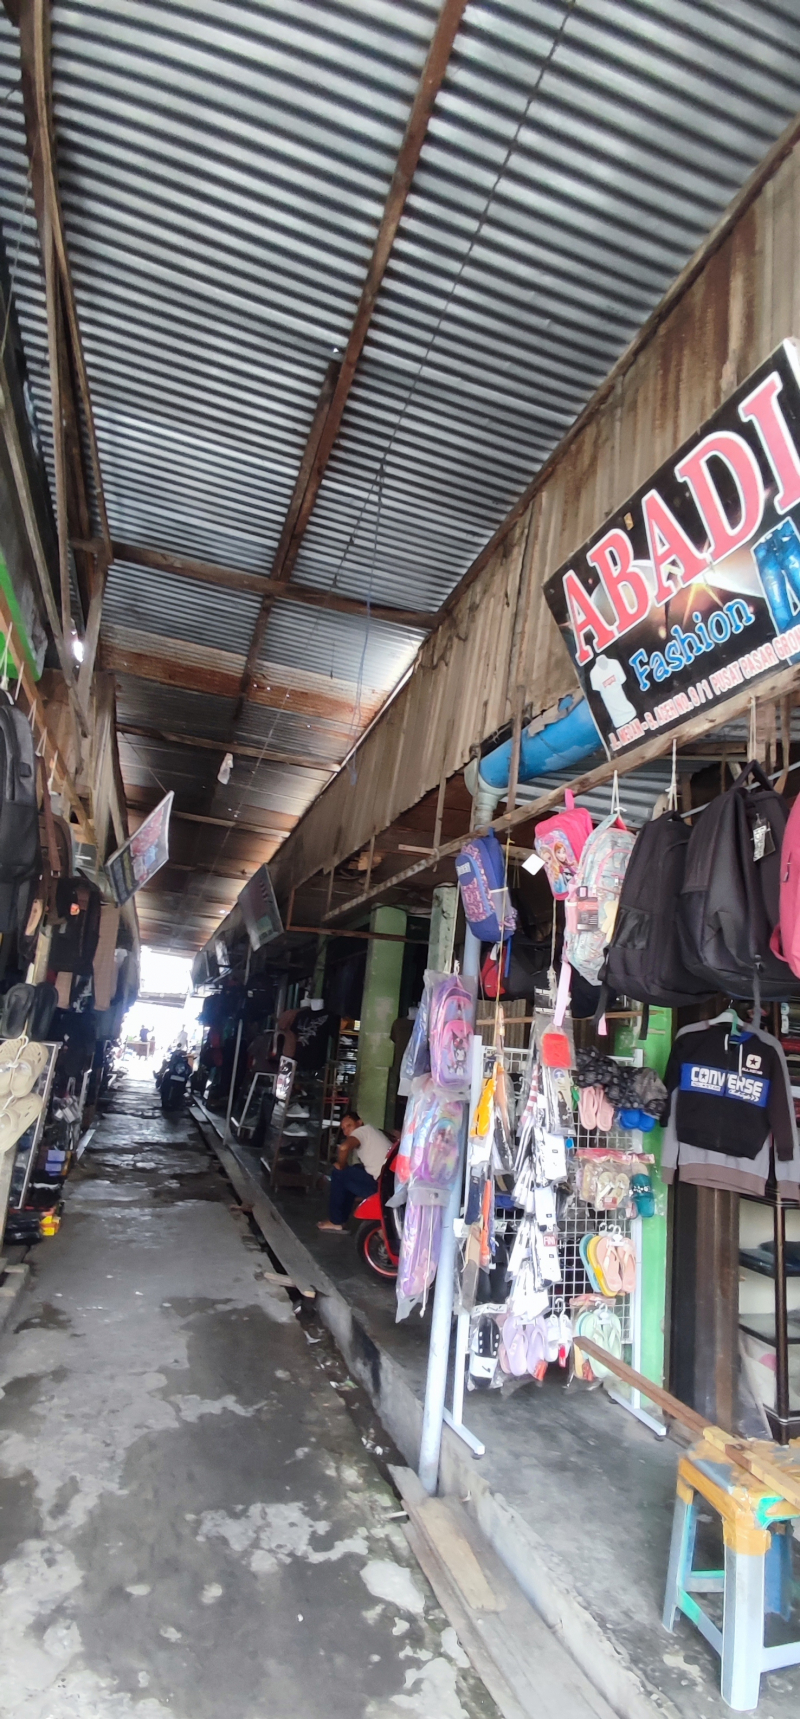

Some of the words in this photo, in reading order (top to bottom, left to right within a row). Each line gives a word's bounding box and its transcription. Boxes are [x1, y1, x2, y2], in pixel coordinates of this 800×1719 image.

[562, 371, 800, 667] ABADI
[629, 599, 755, 691] Fashion
[616, 718, 645, 746] MEDAN
[653, 699, 679, 726] ACEH
[709, 661, 744, 695] PUSAT
[738, 643, 779, 679] PASAR
[691, 1067, 763, 1097] CONVERSE
